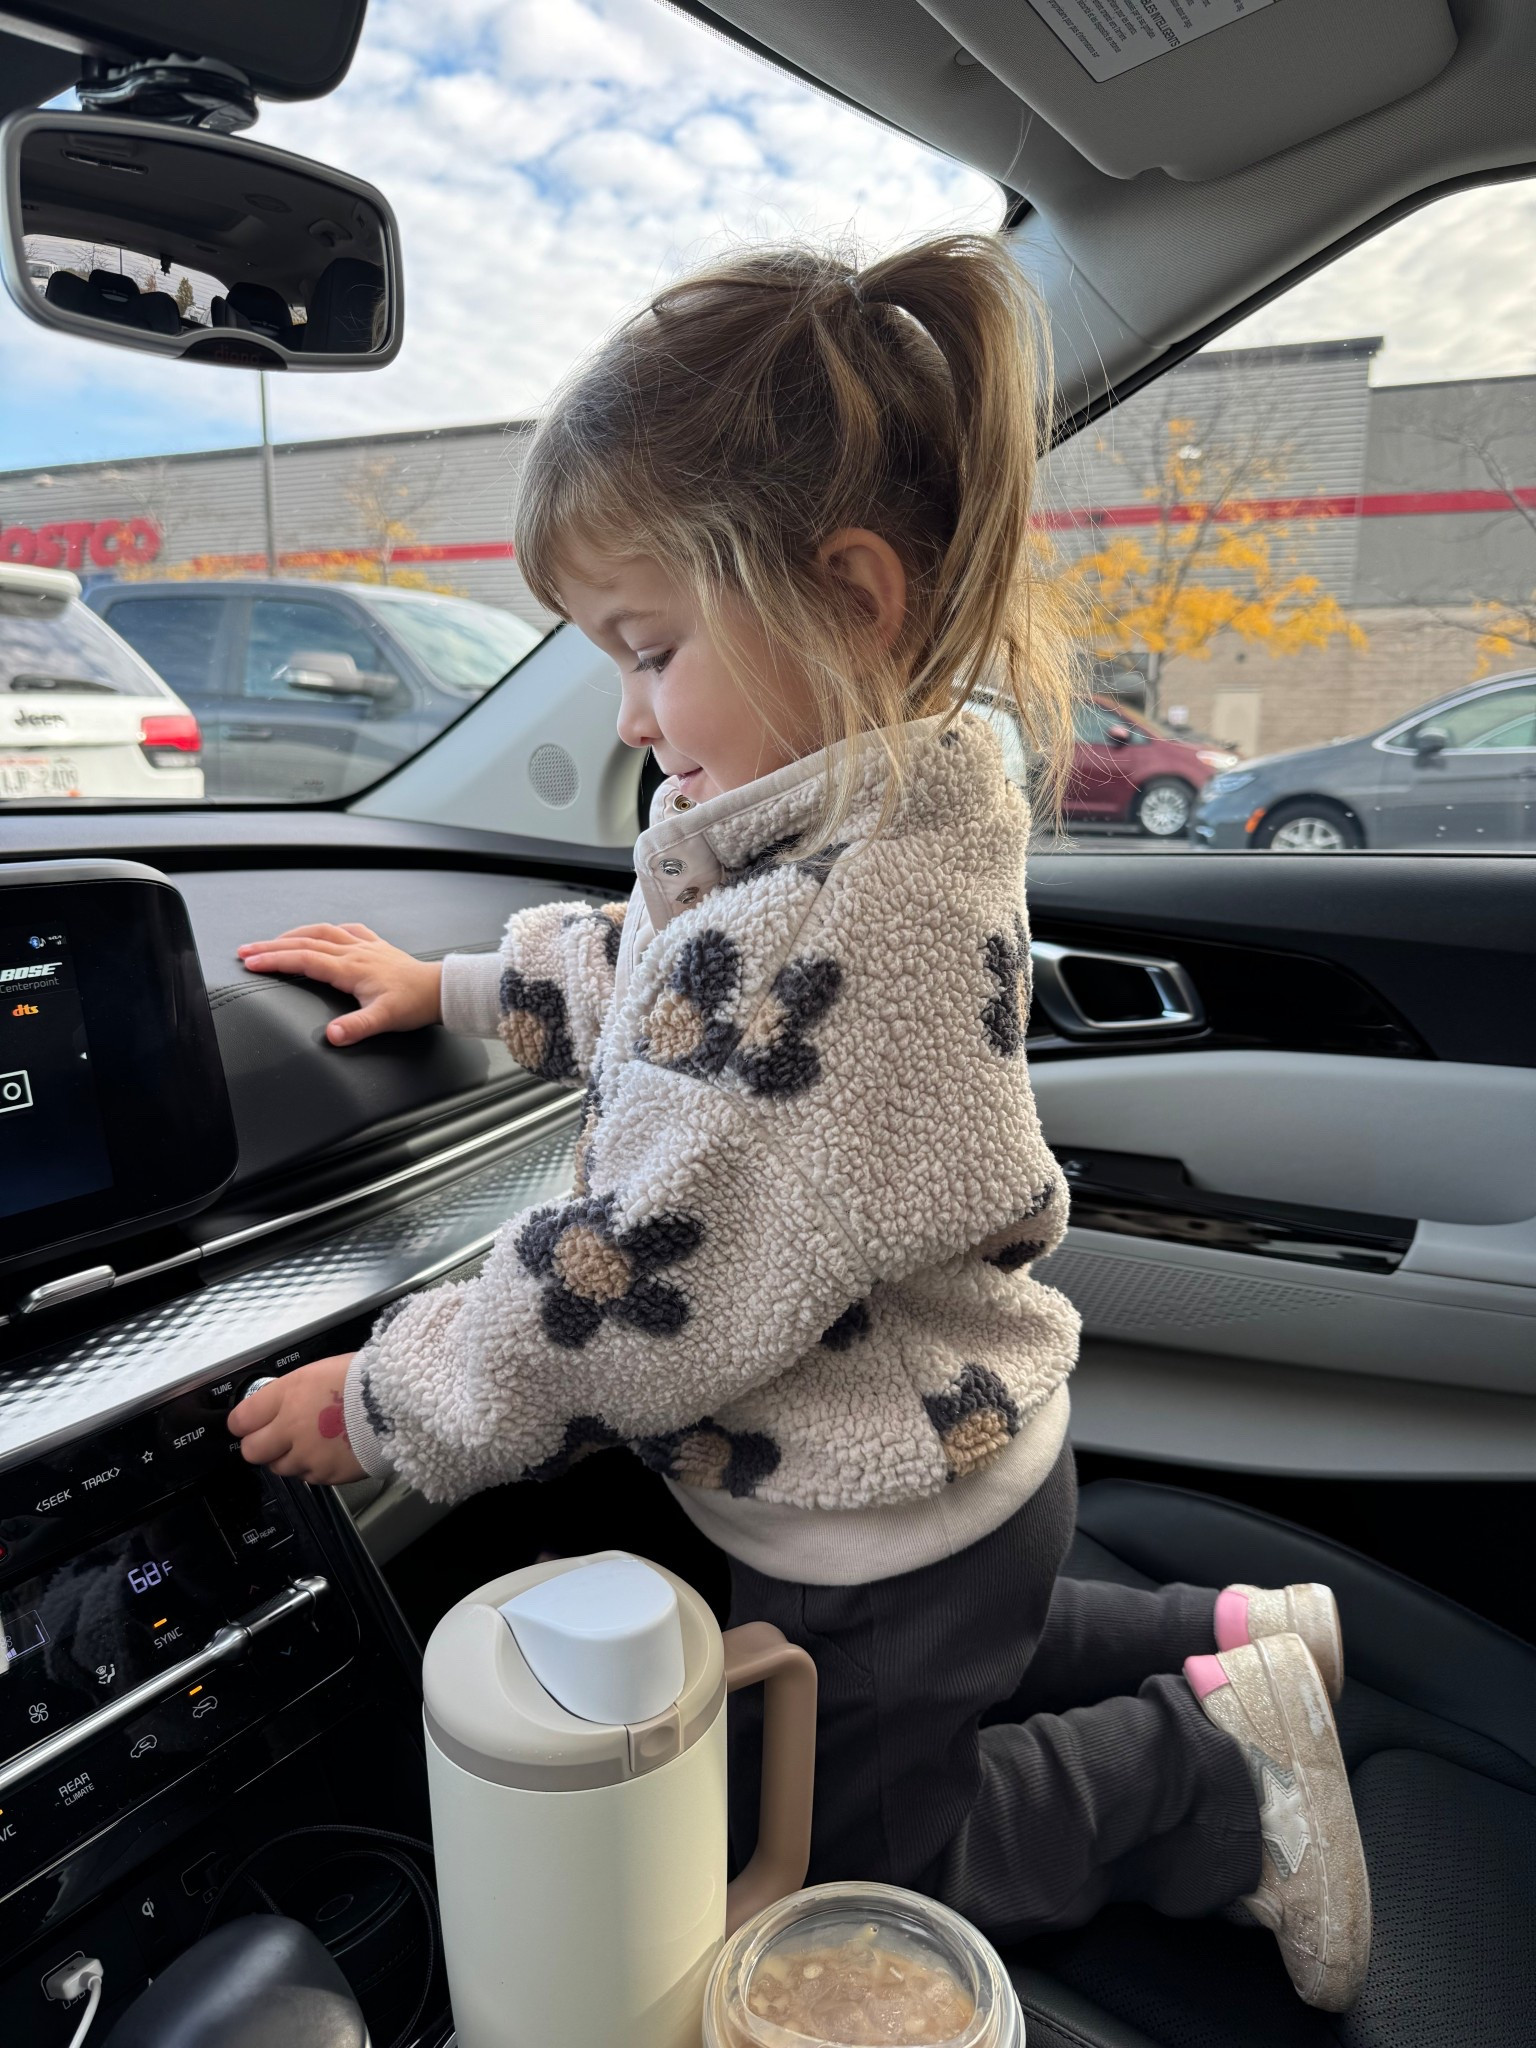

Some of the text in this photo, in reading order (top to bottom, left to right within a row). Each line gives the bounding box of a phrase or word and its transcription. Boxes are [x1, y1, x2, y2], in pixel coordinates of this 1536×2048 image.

[1150, 12, 1181, 47] INTELLIGENTS
[0, 517, 161, 570] OSTCO
[0, 962, 63, 982] BOSE
[0, 977, 60, 993] Centerpoint
[12, 1004, 39, 1017] dts
[276, 1351, 300, 1368] ENTER
[211, 1381, 233, 1396] TUNE
[173, 1426, 206, 1449] SETUP
[259, 1526, 277, 1539] REAR
[153, 1626, 184, 1649] SYNC
[58, 1772, 91, 1798] REAR
[64, 1782, 95, 1807] CLIMATE
